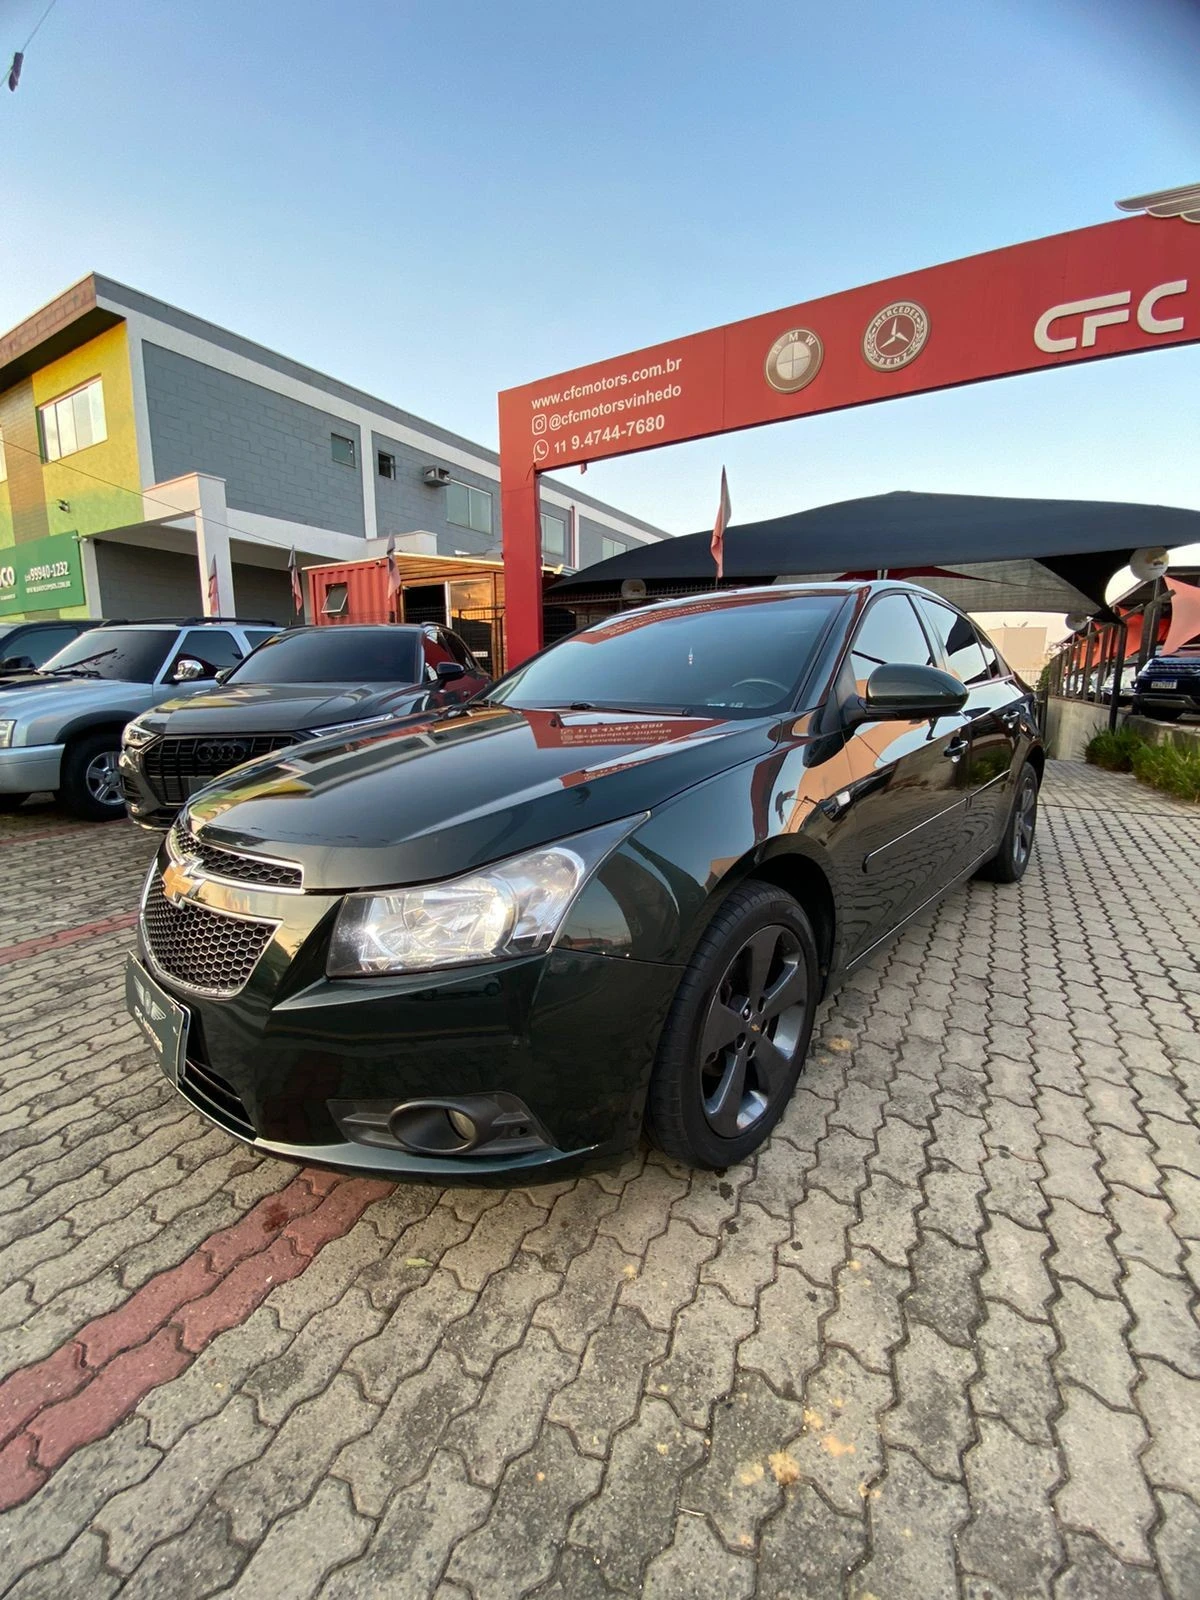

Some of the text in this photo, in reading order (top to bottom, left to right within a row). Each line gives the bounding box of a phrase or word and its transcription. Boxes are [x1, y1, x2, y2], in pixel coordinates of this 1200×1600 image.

[874, 306, 920, 328] MERCEDES
[1034, 279, 1187, 353] CFC
[774, 331, 816, 355] BMW
[879, 354, 908, 366] BENZ
[531, 358, 682, 410] www.cfcmotors.com.br
[549, 384, 682, 431] @cfcmotorsvinhedo
[554, 414, 665, 454] 11 9.4744-7680
